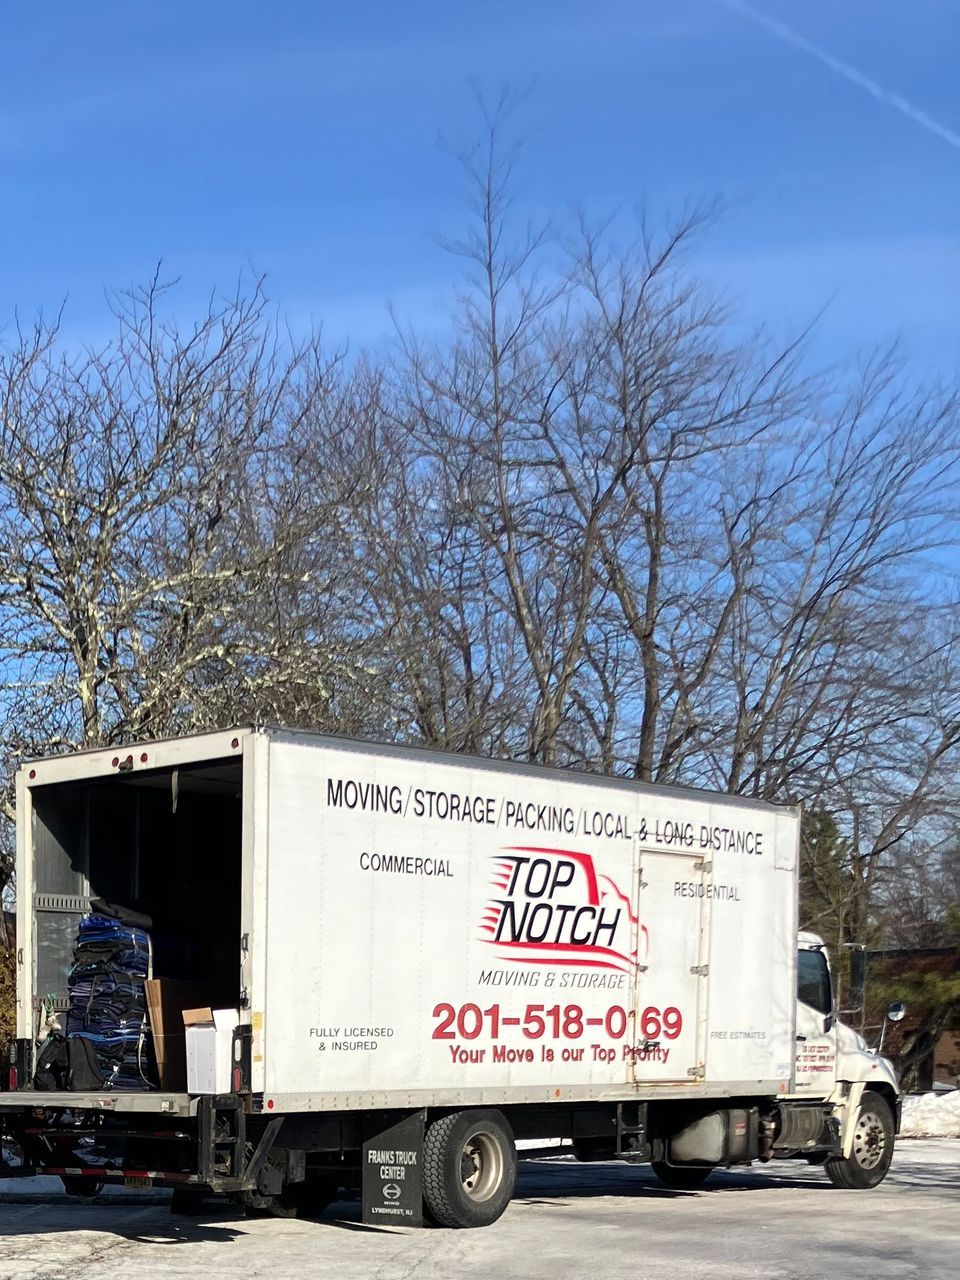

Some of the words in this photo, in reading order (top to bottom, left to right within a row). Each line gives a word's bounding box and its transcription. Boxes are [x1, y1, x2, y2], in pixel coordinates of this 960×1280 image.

[639, 818, 648, 841] &
[655, 819, 694, 846] LONG
[700, 825, 763, 855] DISTANCE
[359, 853, 454, 877] COMMERCIAL
[489, 856, 576, 900] TOP
[673, 881, 740, 901] RESIDENTIAL
[488, 899, 621, 947] NOTCH
[477, 970, 540, 988] MOVING
[544, 972, 556, 989] &
[559, 973, 627, 990] STORAGE
[431, 1002, 683, 1040] 201-518-069
[309, 1027, 341, 1038] FULLY
[344, 1027, 394, 1037] LICENSED
[710, 1031, 728, 1040] FREE
[318, 1041, 327, 1052] &
[331, 1041, 378, 1051] INSURED
[449, 1045, 486, 1064] Your
[492, 1045, 535, 1063] Move
[541, 1045, 555, 1062] Is
[561, 1048, 585, 1062] our
[590, 1044, 617, 1065] Top
[368, 1150, 395, 1164] FRANKS
[395, 1151, 417, 1165] TRUCK
[380, 1165, 405, 1180] CENTER
